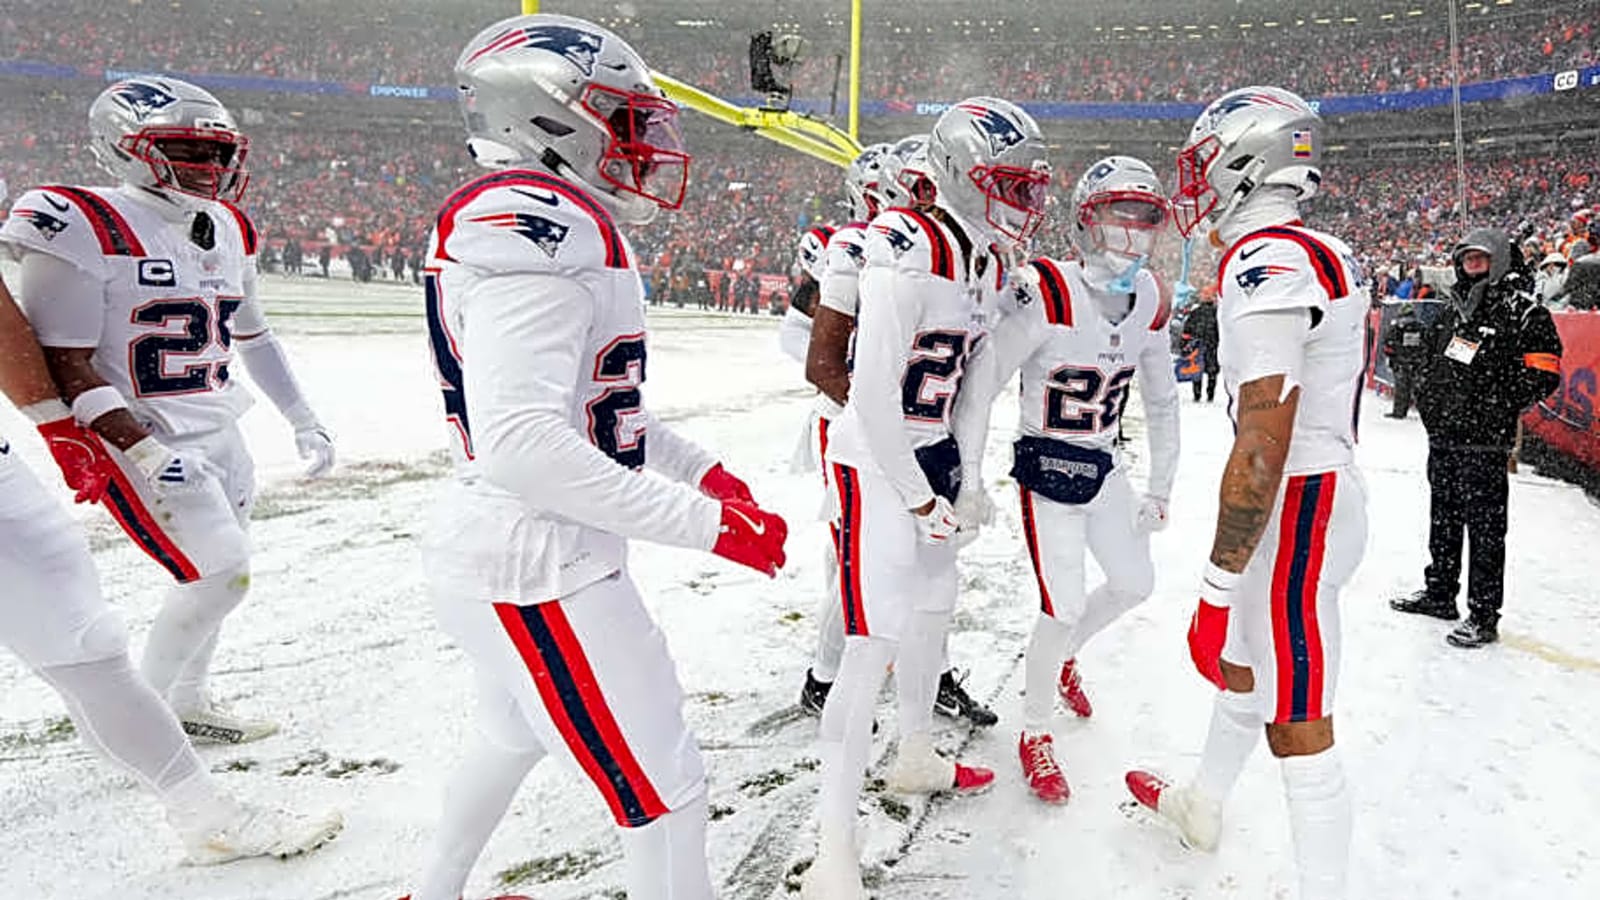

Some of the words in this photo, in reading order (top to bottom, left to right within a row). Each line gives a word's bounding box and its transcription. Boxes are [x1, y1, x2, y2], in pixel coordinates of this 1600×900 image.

[1557, 73, 1576, 88] CC
[916, 102, 952, 115] EMPO
[141, 261, 173, 282] C
